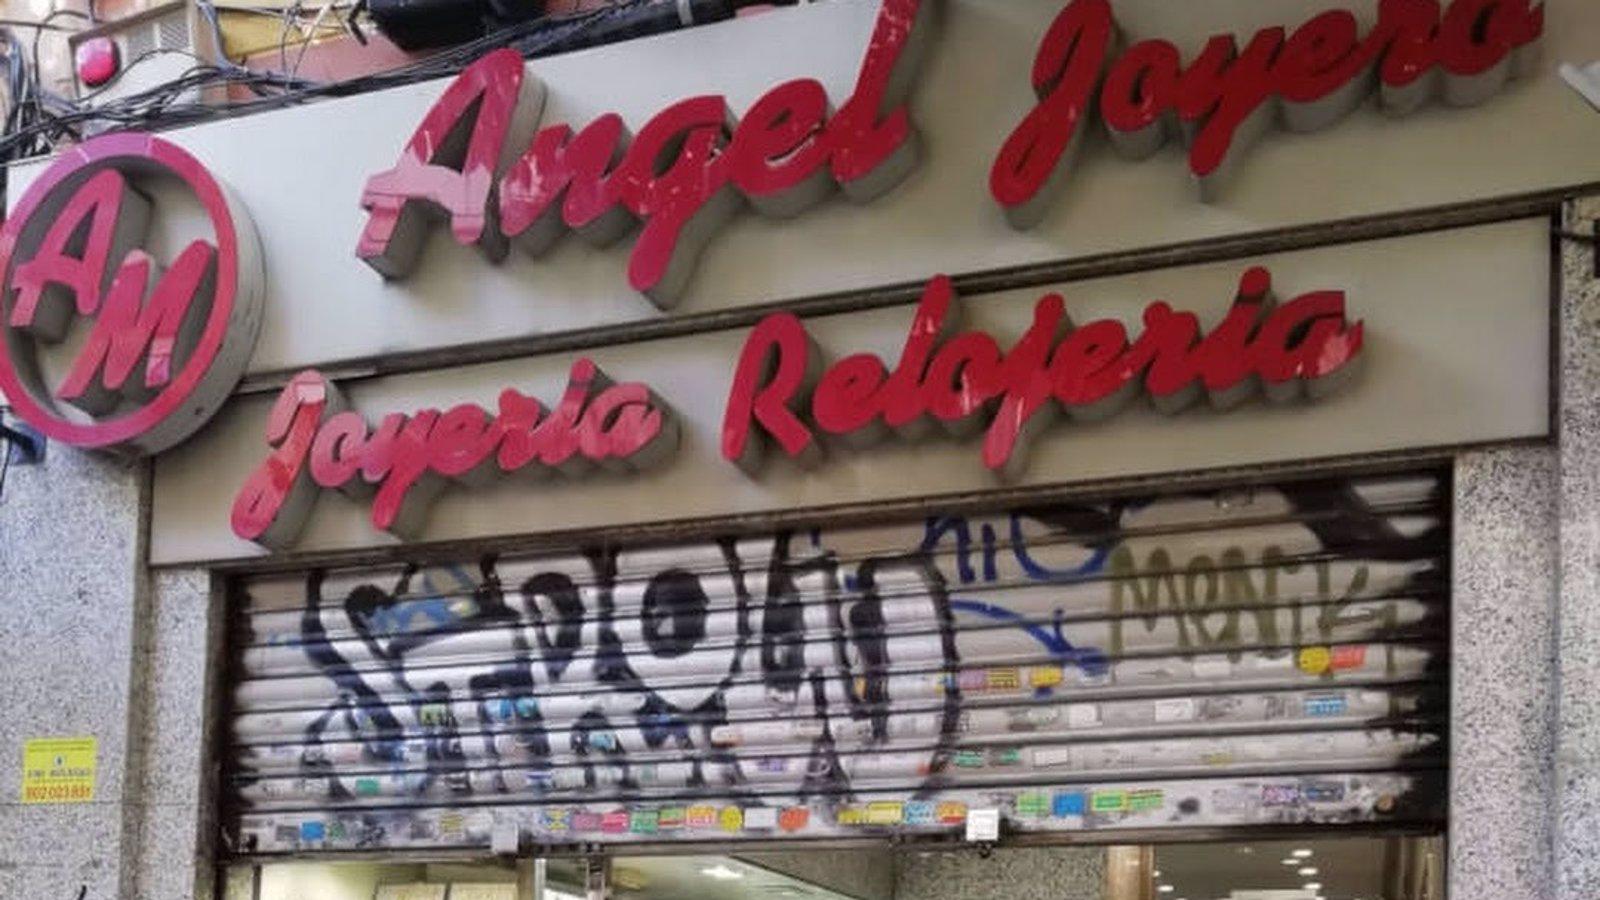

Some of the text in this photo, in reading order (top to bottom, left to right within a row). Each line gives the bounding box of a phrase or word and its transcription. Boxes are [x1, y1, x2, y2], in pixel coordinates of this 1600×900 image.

[356, 0, 920, 294] Angel
[230, 266, 1366, 540] Joyeria Relojeria
